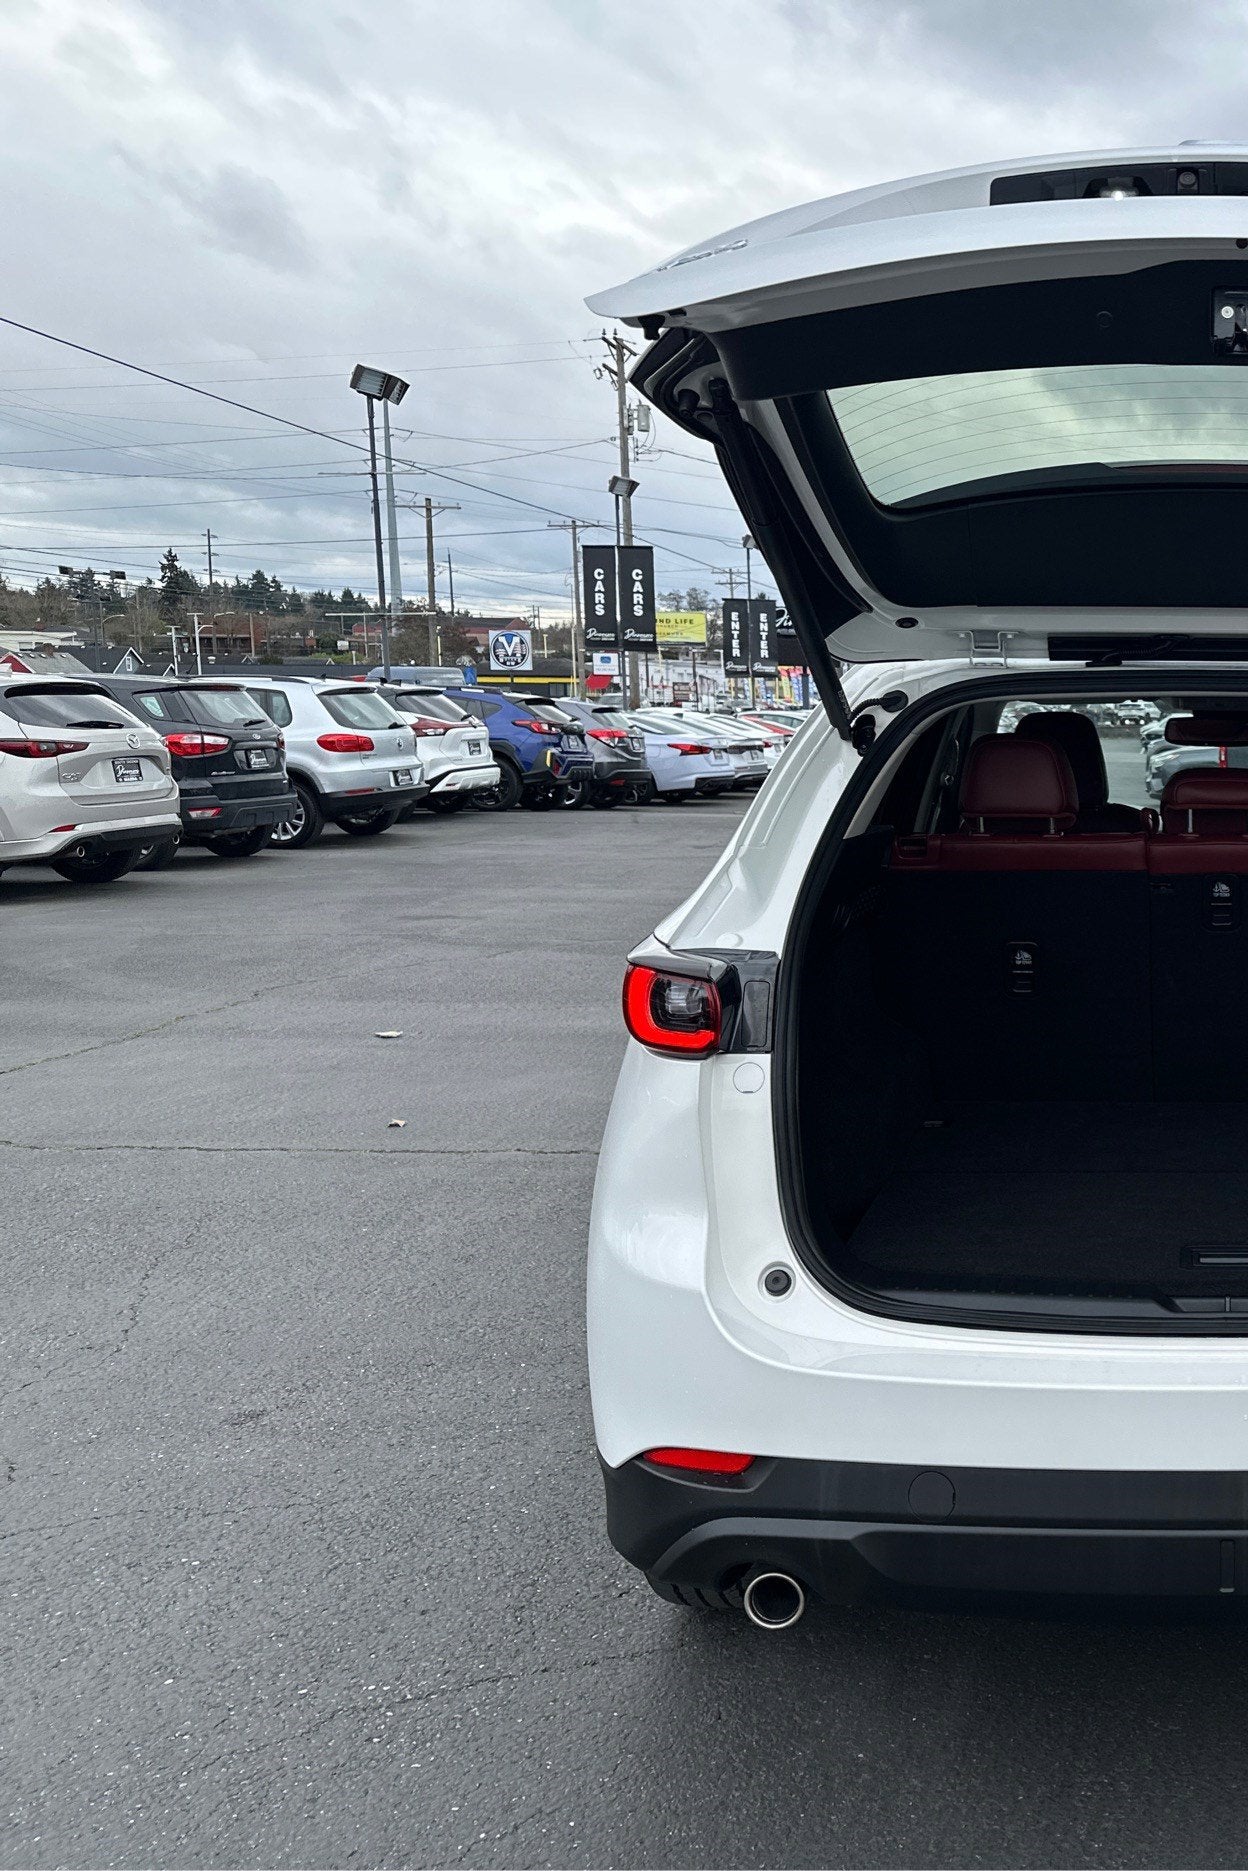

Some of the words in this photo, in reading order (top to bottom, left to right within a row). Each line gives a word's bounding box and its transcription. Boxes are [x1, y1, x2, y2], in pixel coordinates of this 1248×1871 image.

[593, 568, 605, 616] CARS
[631, 568, 644, 617] CARS
[731, 611, 741, 658] ENTER
[759, 613, 770, 659] ENTER
